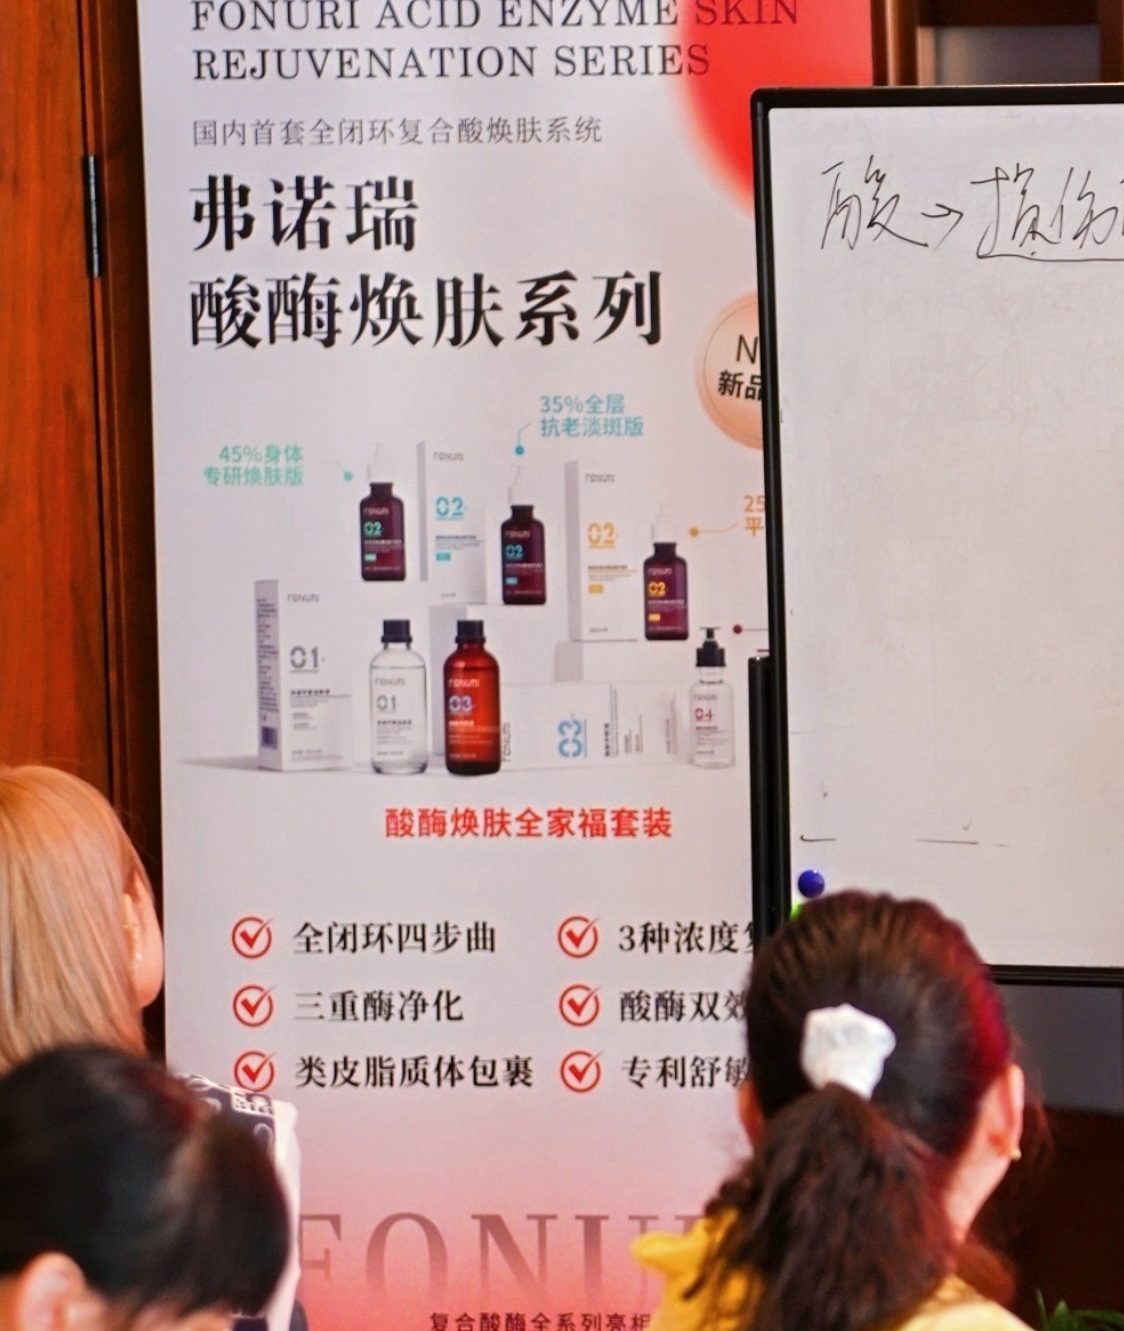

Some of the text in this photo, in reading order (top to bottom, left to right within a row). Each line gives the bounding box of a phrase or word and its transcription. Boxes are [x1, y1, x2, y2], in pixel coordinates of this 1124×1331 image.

[192, 44, 711, 82] REJUVENATION SERIES
[193, 116, 602, 147] 国内首套全闭环复合酸焕肤系统
[190, 173, 419, 253] 弗诺瑞
[190, 268, 663, 350] 酸酶焕肤系列
[540, 416, 645, 438] 抗老淡斑版
[219, 444, 304, 463] 45%身体
[385, 806, 673, 839] 酸酶焕肤全家福套装
[292, 920, 497, 955] 全闭环四步曲
[293, 989, 465, 1024] 三重酶净化
[294, 1055, 533, 1089] 类皮脂质体包裹
